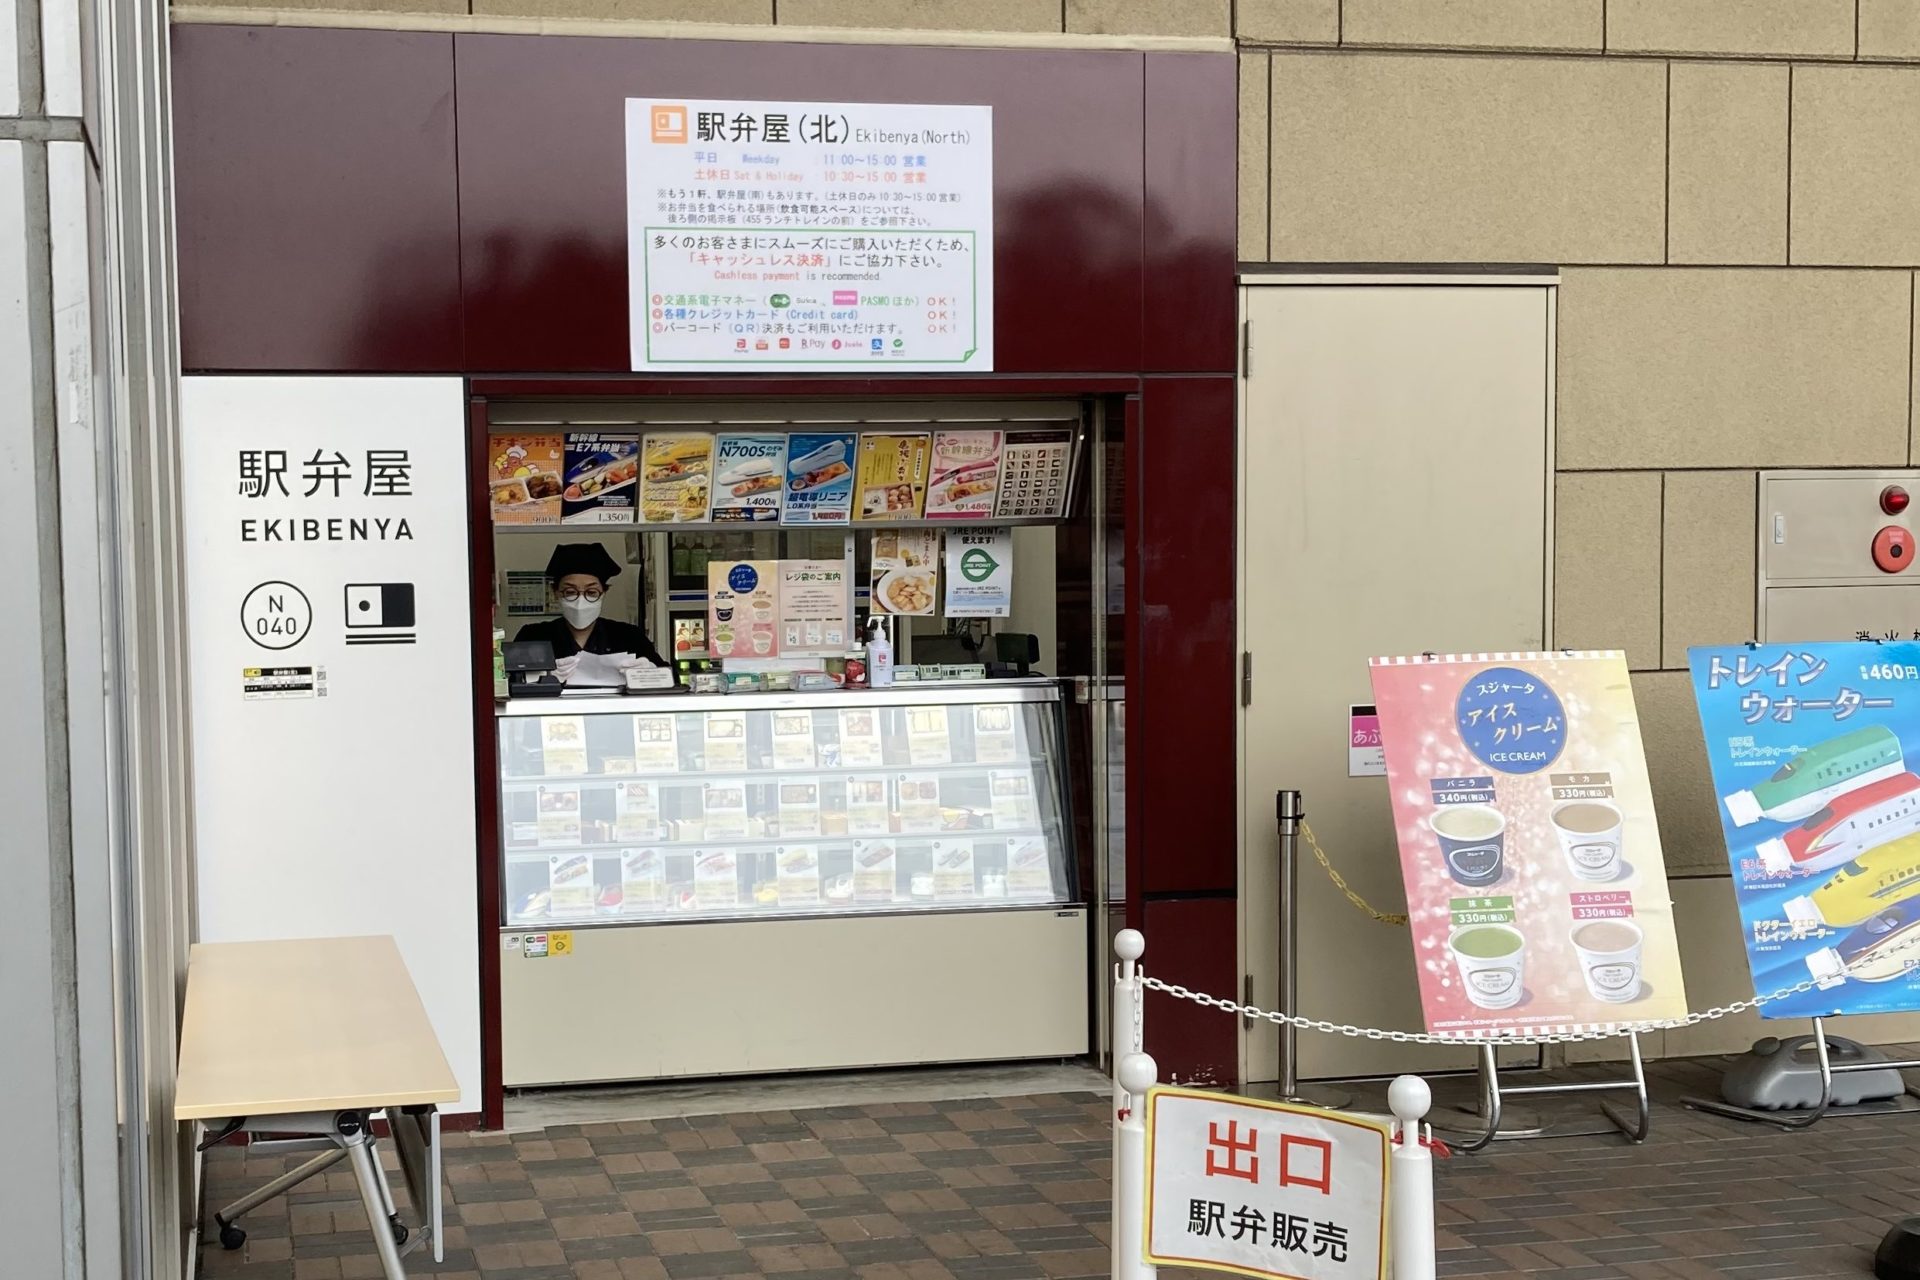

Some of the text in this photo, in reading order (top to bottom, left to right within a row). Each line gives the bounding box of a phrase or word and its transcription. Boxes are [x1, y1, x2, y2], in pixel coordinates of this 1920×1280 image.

[697, 112, 971, 145] 駅弁屋（北） Ekibenya(North)
[694, 152, 718, 163] 平日
[903, 155, 927, 167] 営業
[694, 169, 730, 180] 土休日
[903, 172, 927, 184] 営業
[654, 236, 969, 252] 多くのお客さまにスムーズにご購入いただくため、
[714, 270, 758, 280] Cashless
[762, 272, 800, 283] payment
[807, 272, 816, 281] is
[719, 445, 766, 457] N700S
[238, 448, 413, 498] 駅弁屋
[241, 518, 414, 542] EKIBENYA
[953, 527, 969, 535] JRE
[786, 572, 841, 582] レジ袋のご案内
[269, 595, 283, 613] N
[256, 617, 297, 636] 040
[1855, 628, 1920, 642] 消火
[1708, 651, 1828, 690] トレイン
[1475, 681, 1536, 696] スジャータ
[1739, 687, 1895, 724] ウォーター
[1466, 702, 1518, 728] アイス
[1493, 716, 1559, 746] クリーム
[1489, 751, 1547, 763] ICE CREAM
[1446, 779, 1476, 788] バニラ
[1568, 775, 1591, 784] モカ
[1578, 894, 1626, 904] ストロベリー
[1205, 1119, 1332, 1196] 出口
[1187, 1198, 1349, 1263] 駅弁販売
